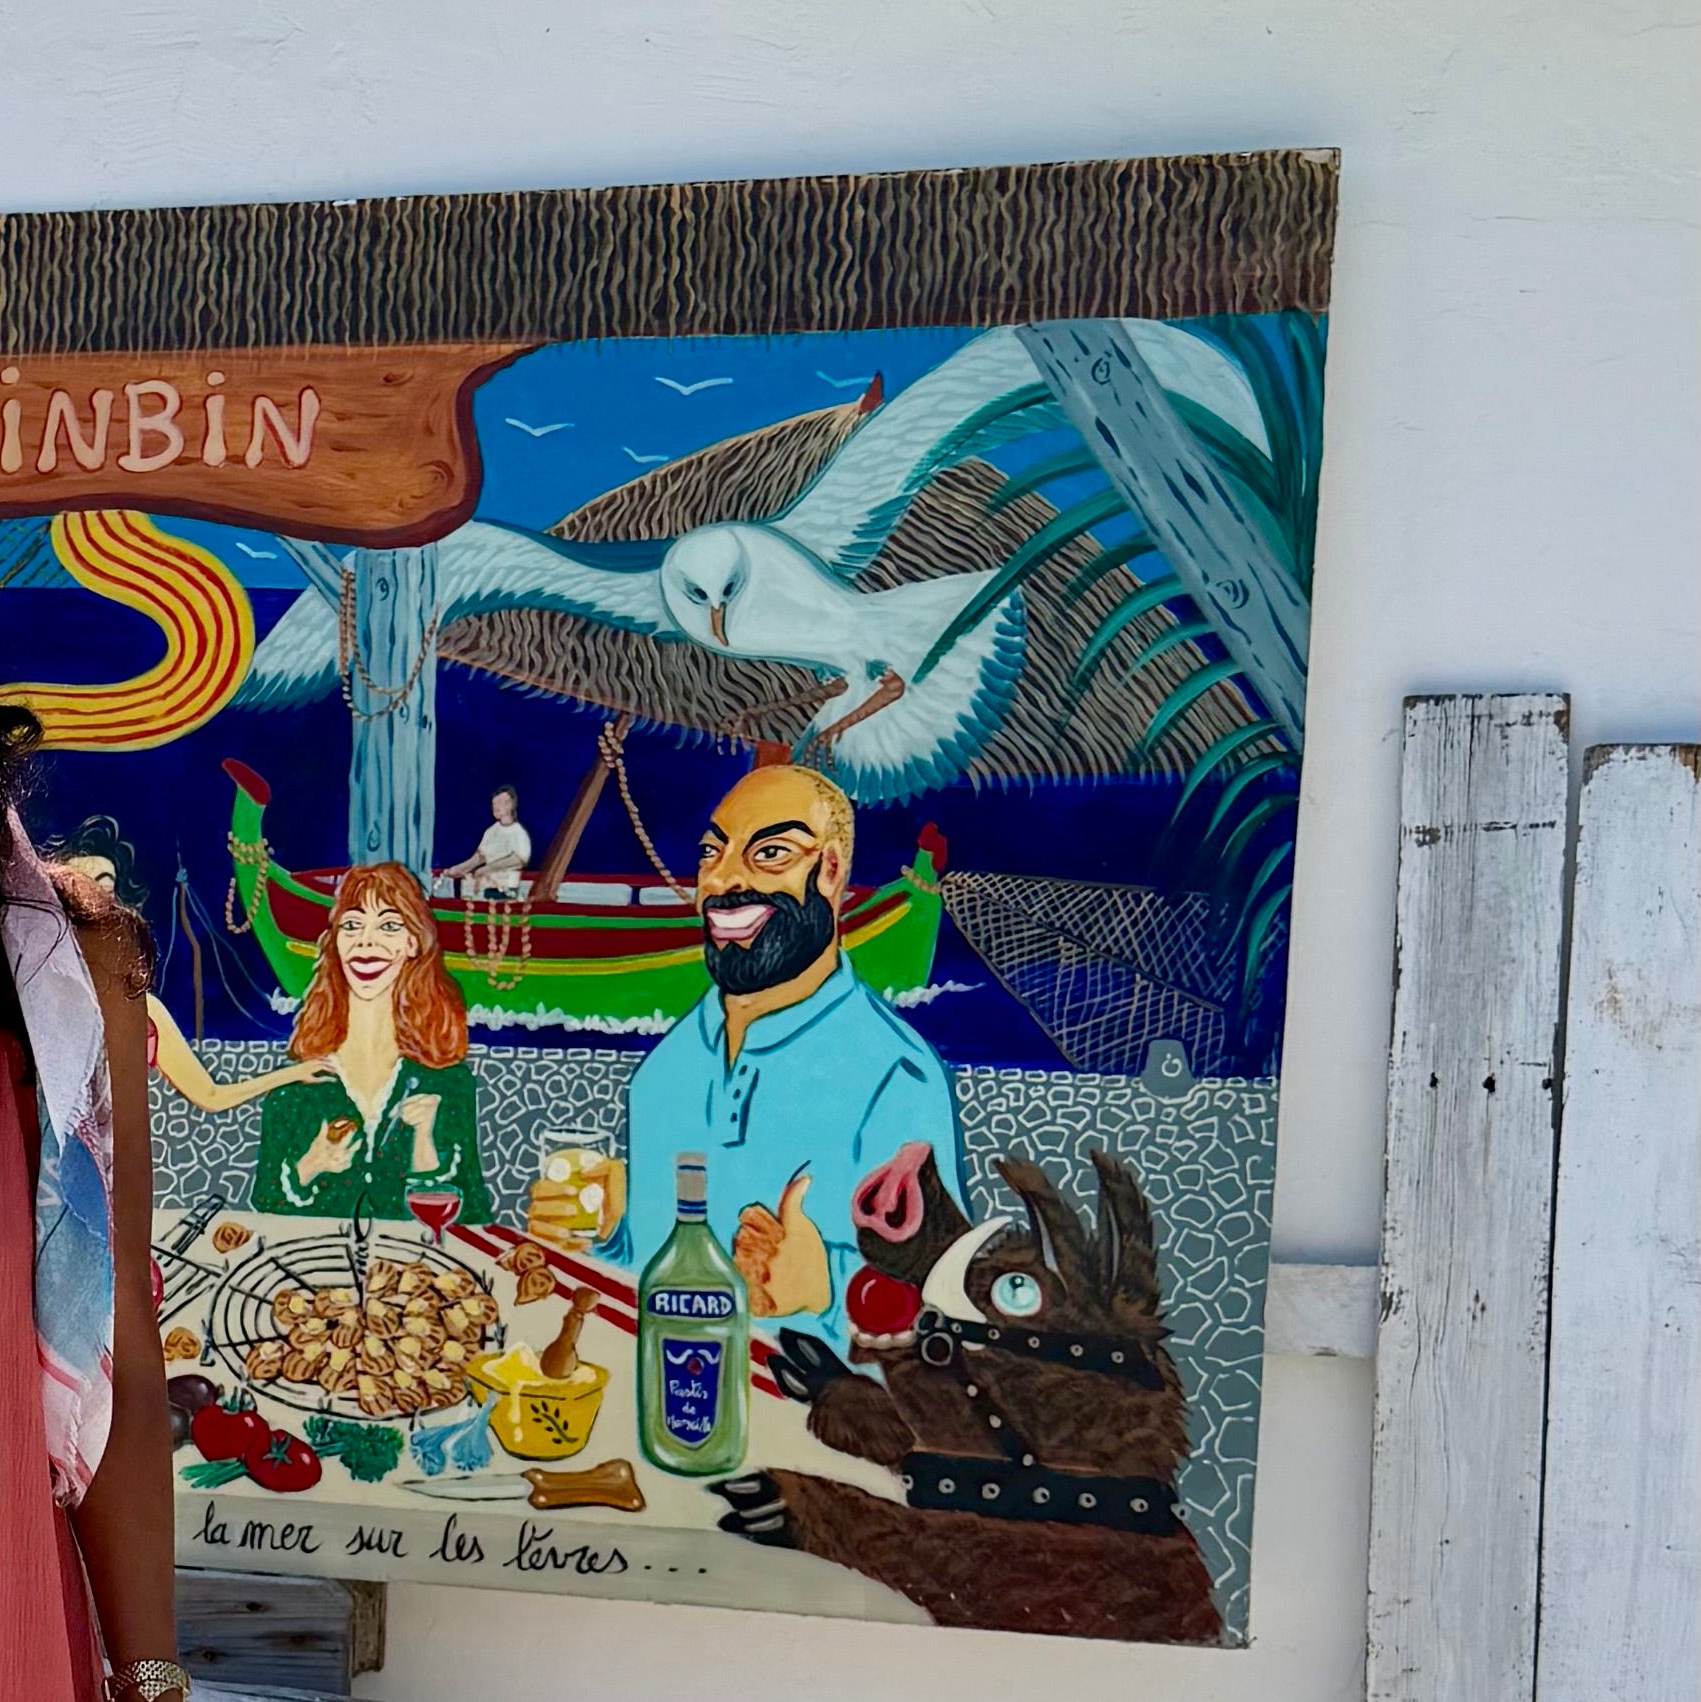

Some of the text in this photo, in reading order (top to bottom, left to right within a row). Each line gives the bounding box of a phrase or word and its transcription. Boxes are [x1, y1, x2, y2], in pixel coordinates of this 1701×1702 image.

[654, 1292, 733, 1315] RICARD
[681, 1401, 697, 1415] de
[193, 1501, 231, 1546] la
[240, 1522, 325, 1555] mer
[345, 1526, 410, 1559] sur
[429, 1513, 487, 1565] les
